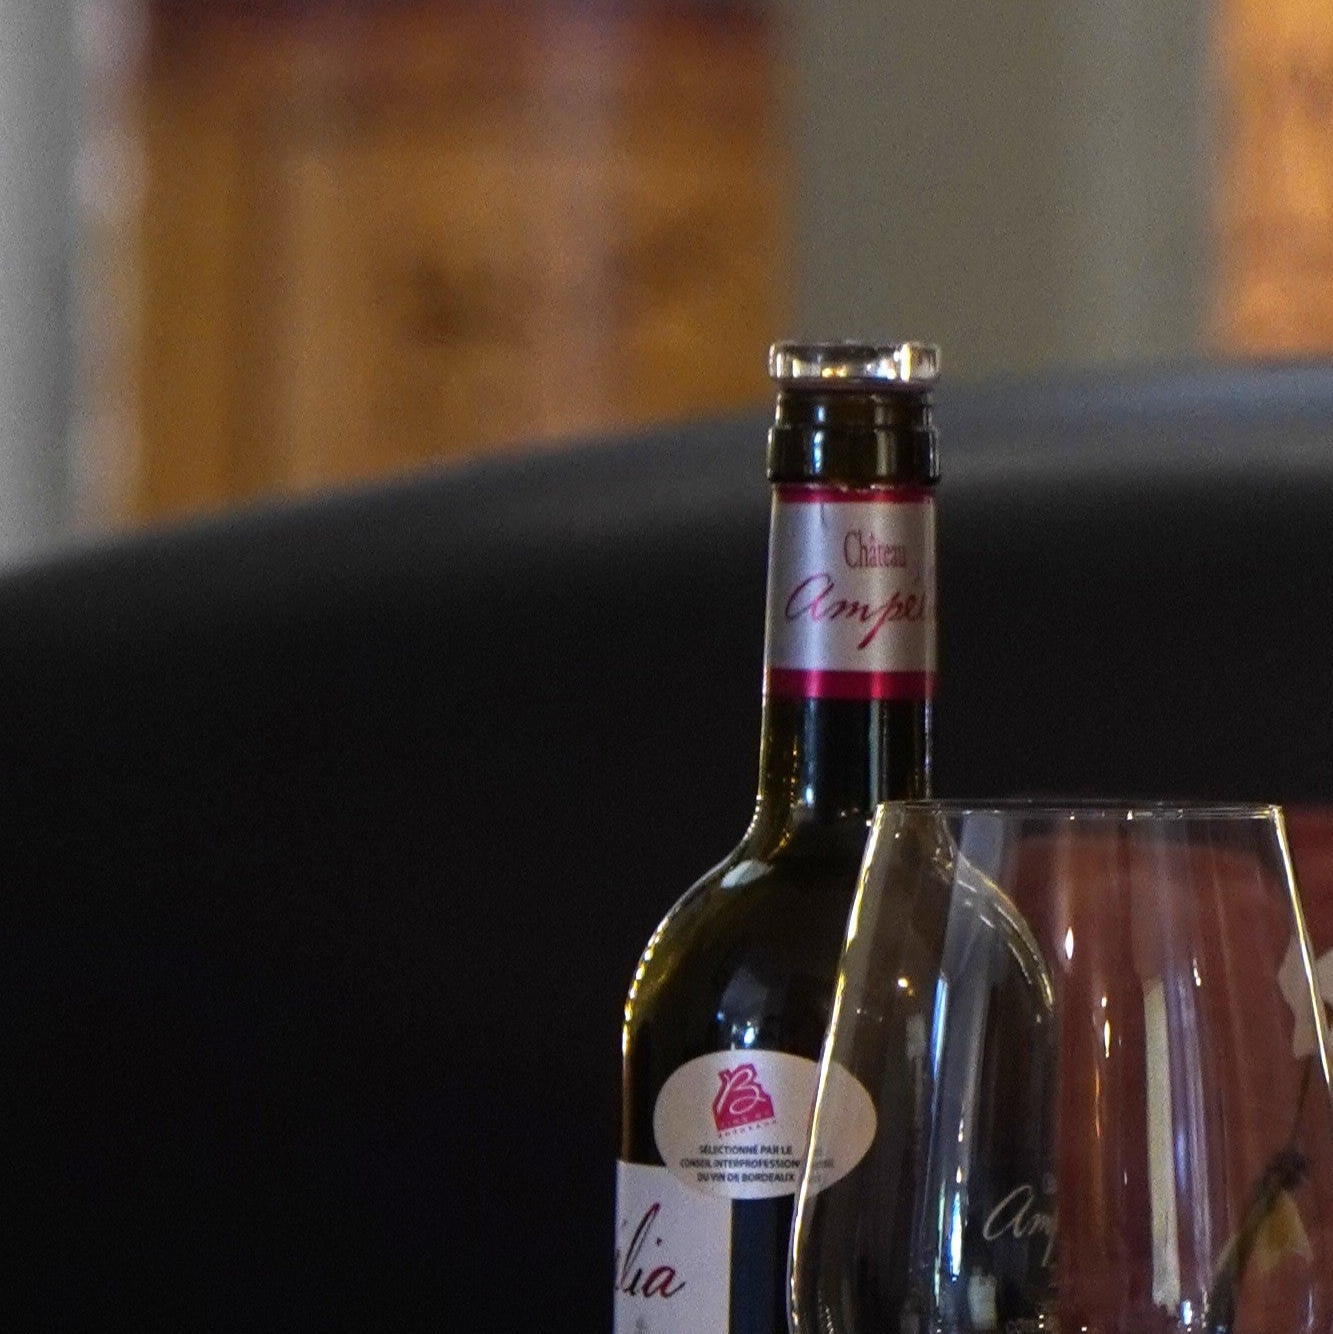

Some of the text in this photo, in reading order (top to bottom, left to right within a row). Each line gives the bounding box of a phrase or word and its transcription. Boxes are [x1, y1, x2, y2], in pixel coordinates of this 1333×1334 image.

[843, 529, 907, 568] Château
[699, 1143, 793, 1156] SÉLECTIONNÉ PAR LE
[679, 1158, 712, 1169] CONSEIL
[697, 1172, 795, 1183] DU VIN DE BORDEAUX
